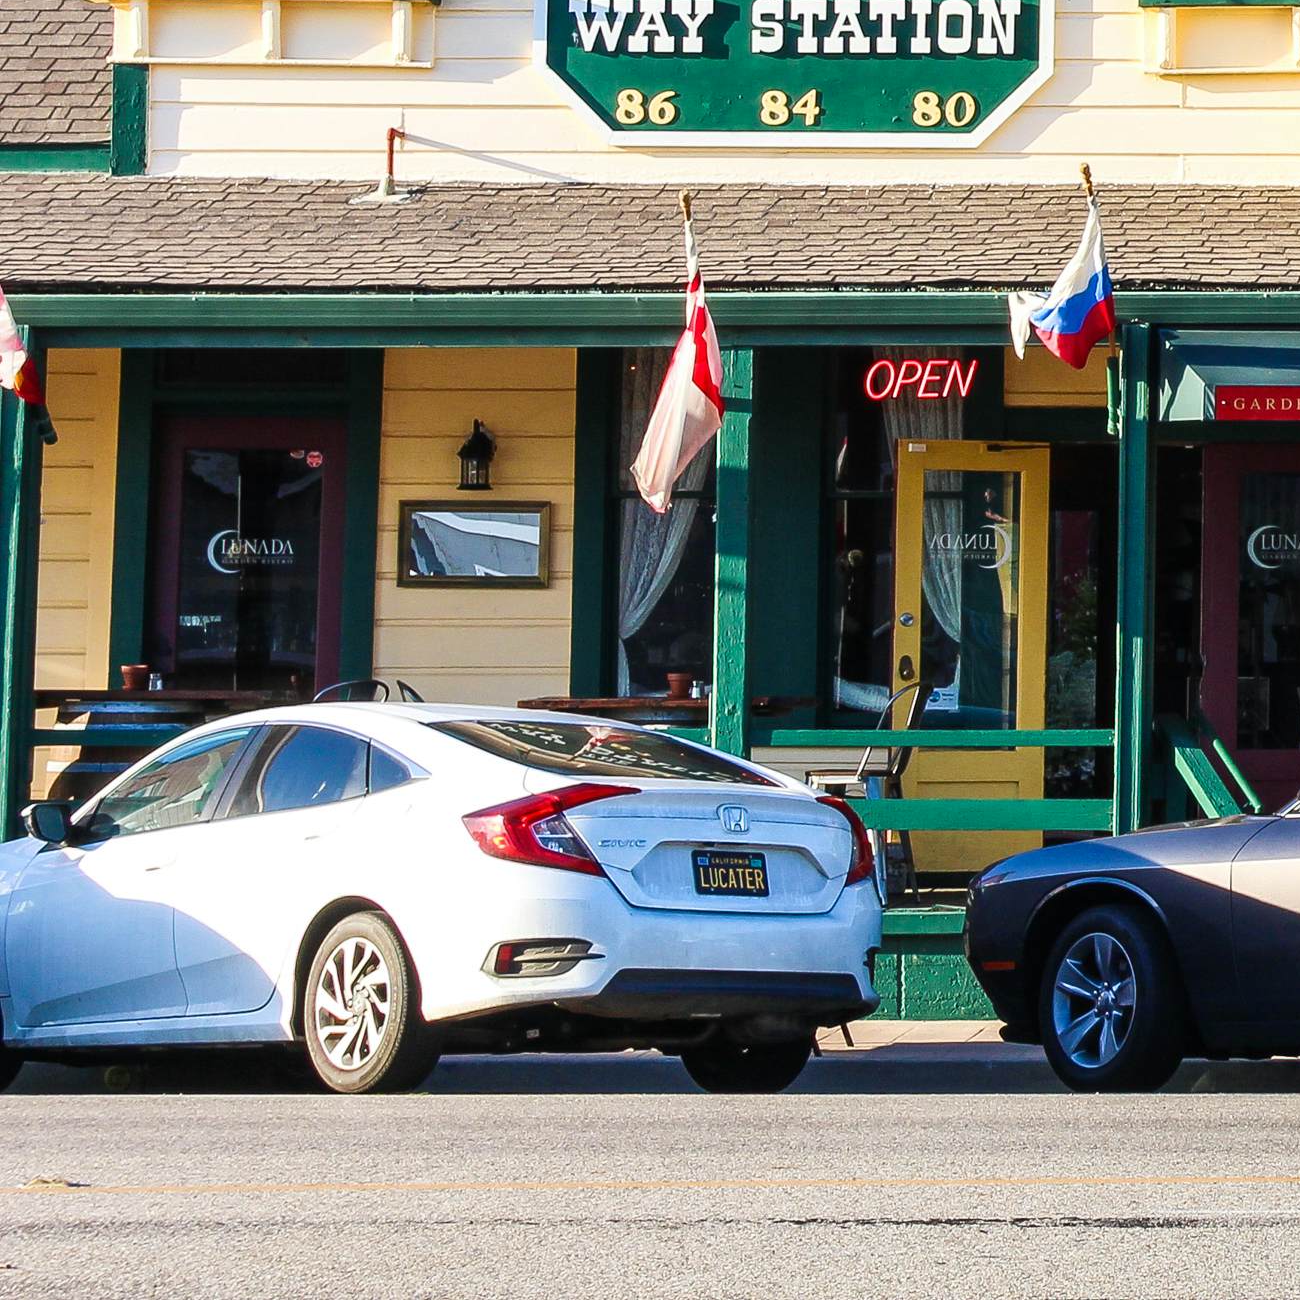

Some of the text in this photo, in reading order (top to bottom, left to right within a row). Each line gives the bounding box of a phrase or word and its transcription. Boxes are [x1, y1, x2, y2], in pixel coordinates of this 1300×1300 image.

[615, 89, 976, 128] 86 84 80
[864, 358, 979, 400] OPEN
[221, 539, 294, 555] LUNADA
[600, 839, 647, 848] CIVIC
[699, 867, 764, 890] LUCATER
